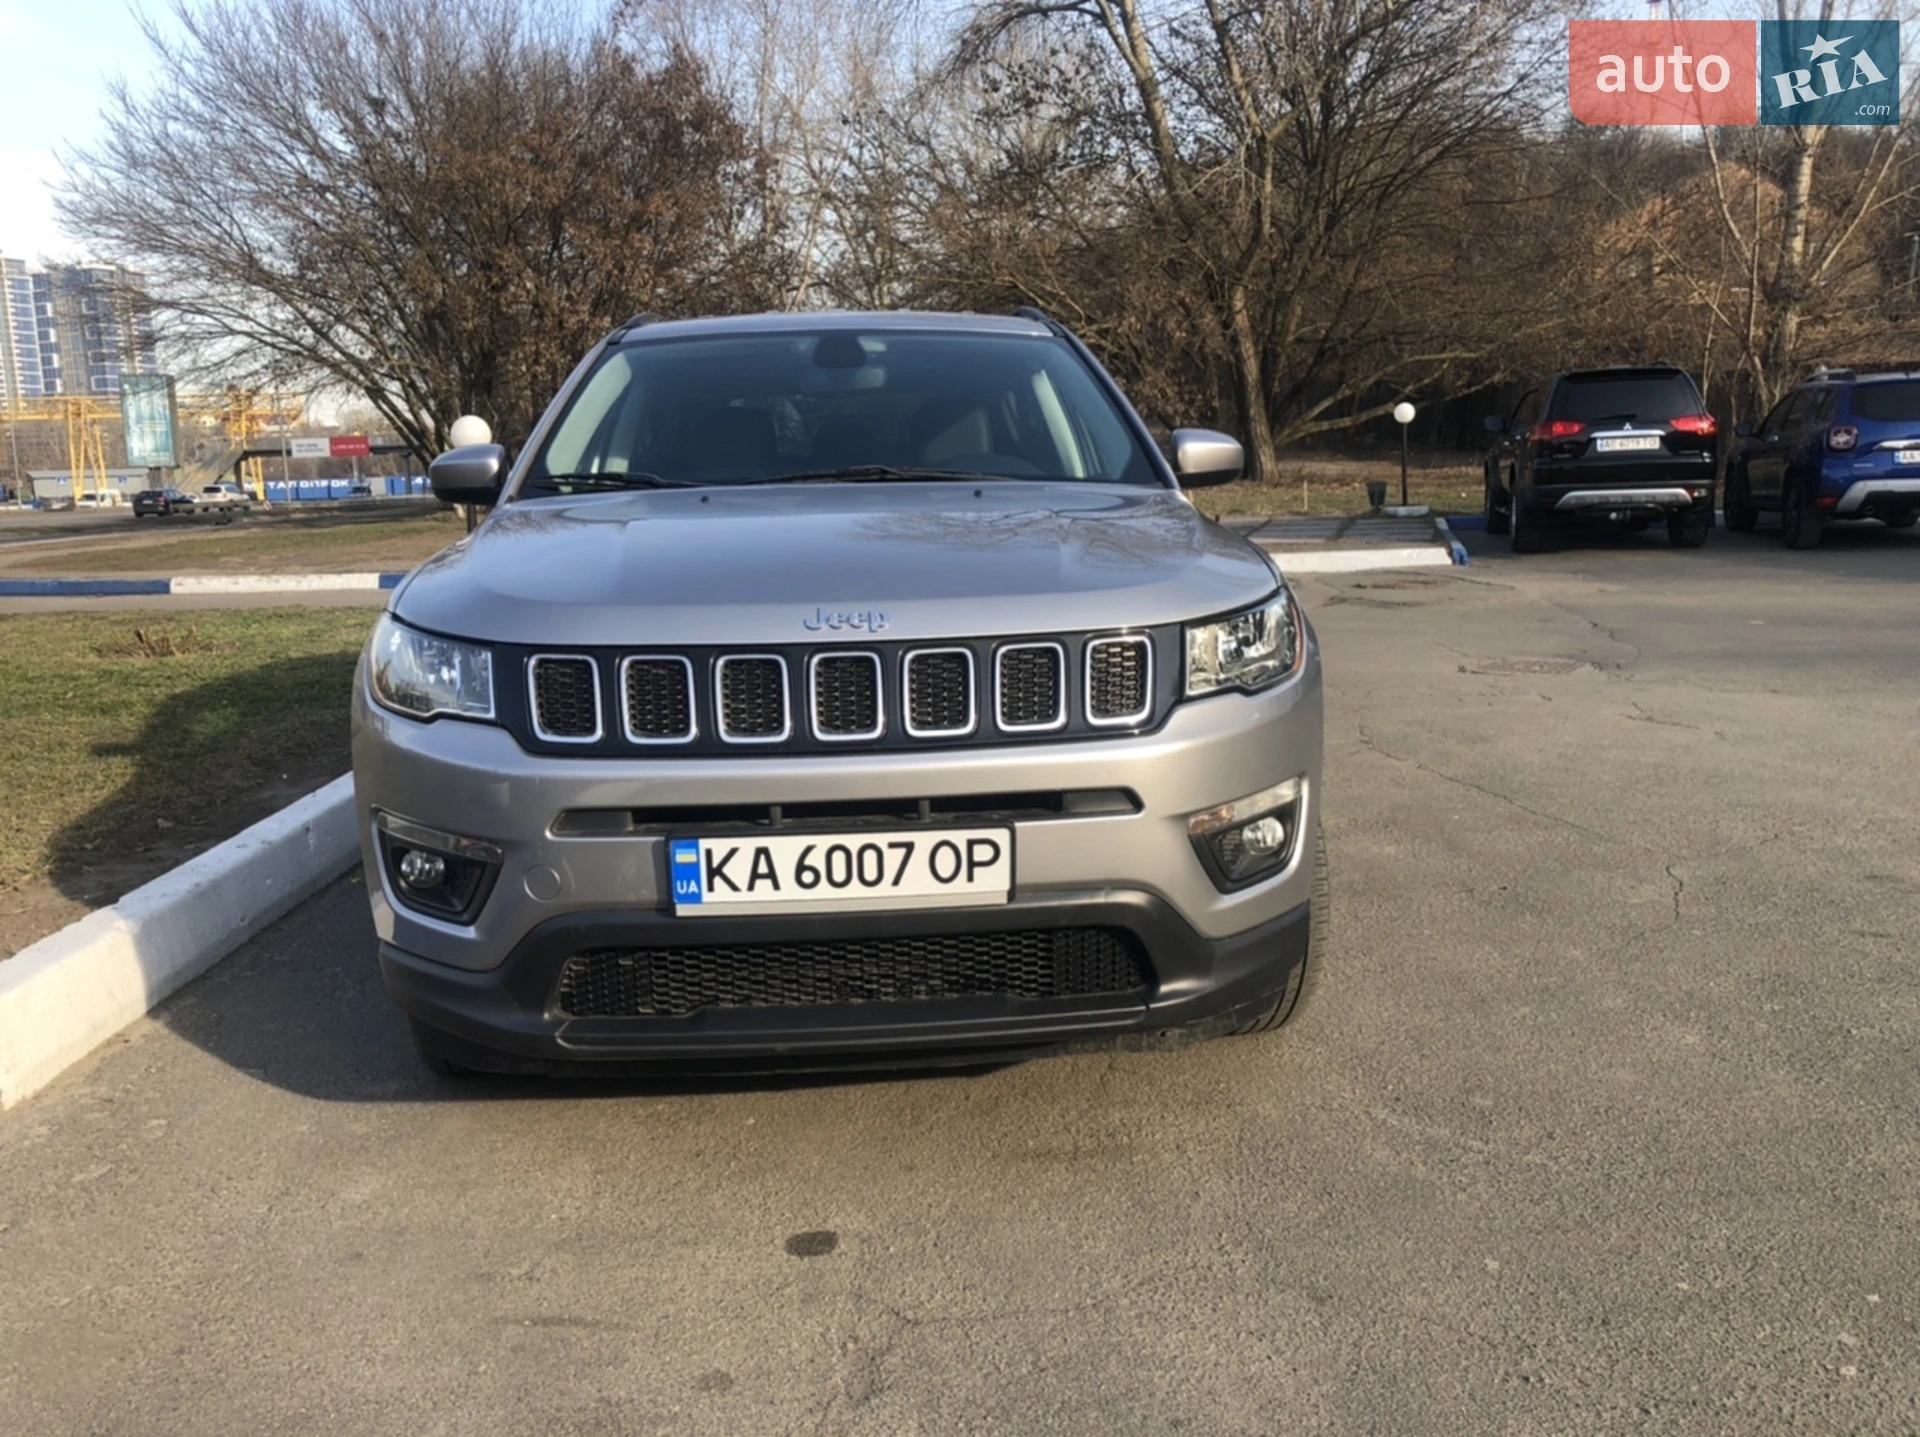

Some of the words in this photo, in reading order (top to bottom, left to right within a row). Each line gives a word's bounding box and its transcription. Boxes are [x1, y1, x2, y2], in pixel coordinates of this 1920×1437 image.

[802, 606, 890, 633] Jeep
[704, 846, 781, 892] KA
[794, 841, 915, 890] 6007
[928, 838, 1002, 884] OP
[676, 880, 699, 894] UA
